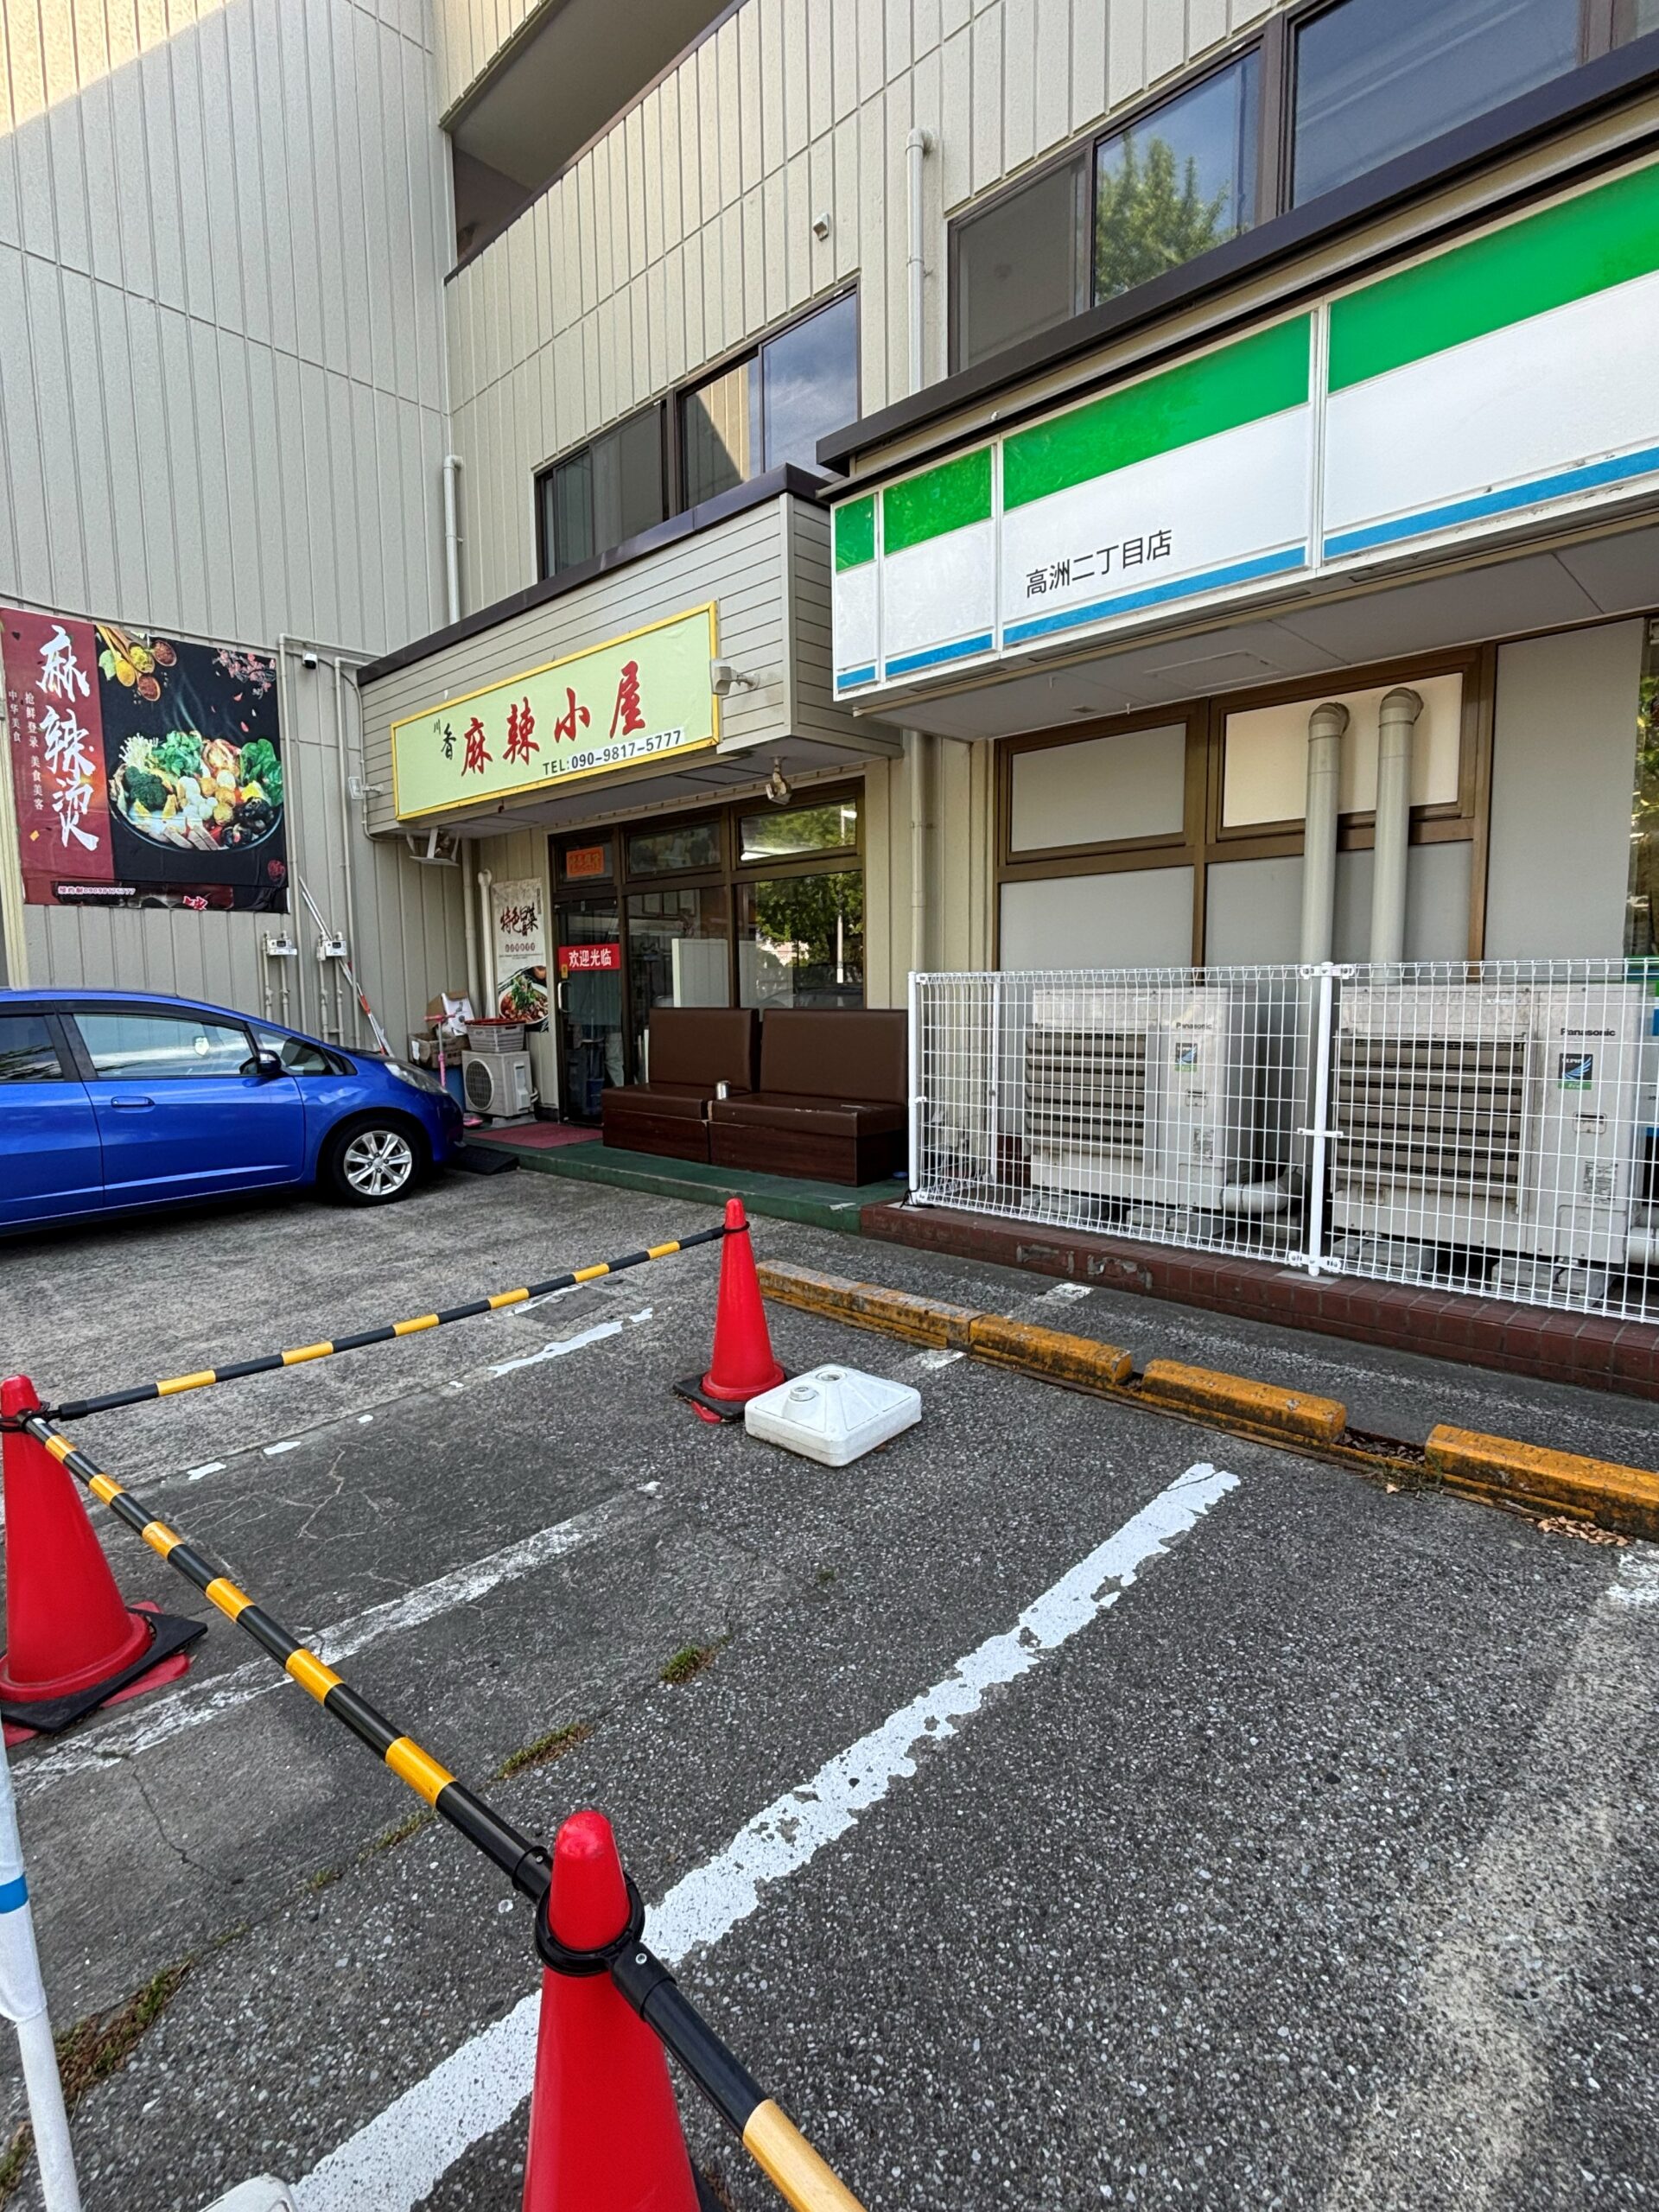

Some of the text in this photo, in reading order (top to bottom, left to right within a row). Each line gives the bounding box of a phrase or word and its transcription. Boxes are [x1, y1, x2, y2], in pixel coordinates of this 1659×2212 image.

[1026, 529, 1173, 599] 高洲二丁目店
[461, 659, 645, 777] 麻辣小屋
[542, 729, 682, 776] TEL:090-9817-5777
[569, 948, 612, 968] 欢迎光临
